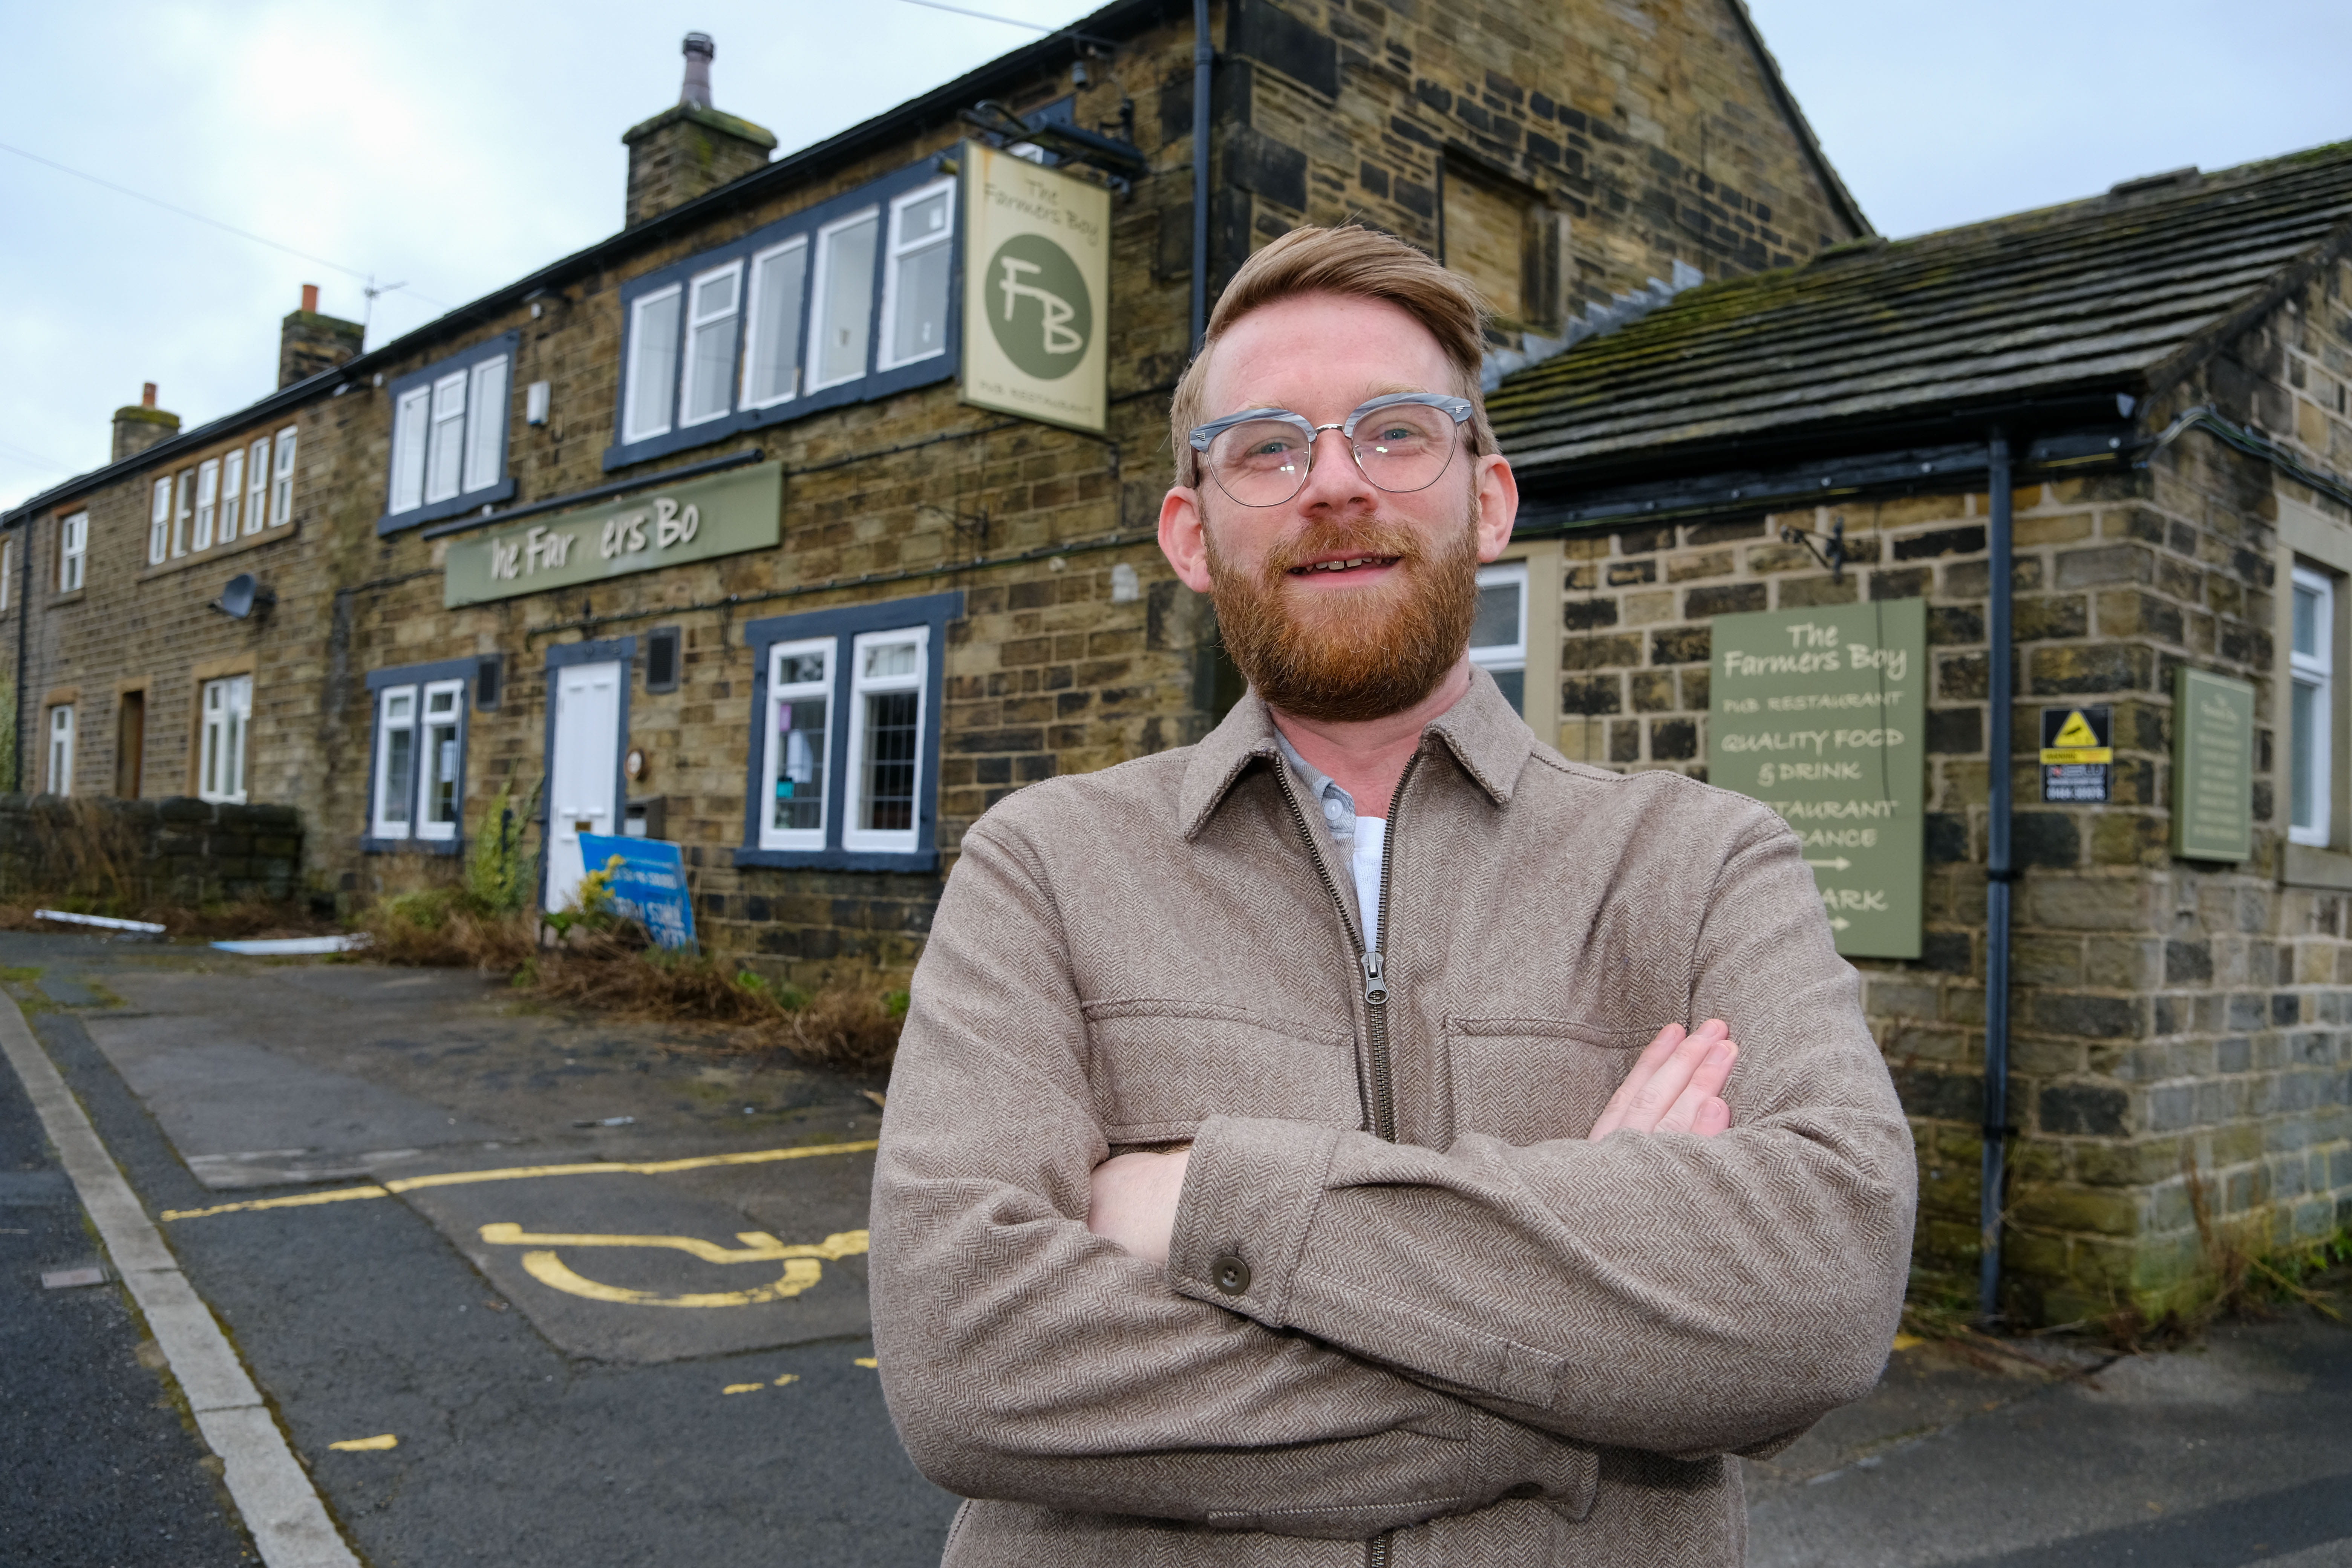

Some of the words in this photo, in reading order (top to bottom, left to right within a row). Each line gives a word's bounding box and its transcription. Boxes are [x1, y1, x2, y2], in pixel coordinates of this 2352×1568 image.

[1024, 179, 1060, 207] The
[983, 182, 1062, 225] Farmers
[1064, 208, 1099, 248] Boy
[1787, 622, 1839, 649] The
[1724, 650, 1841, 677] Farmers
[1847, 643, 1907, 680] Boy
[1723, 698, 1760, 714] PUB
[1768, 691, 1905, 711] RESTAURANT
[1721, 730, 1829, 756] QUALITY
[1834, 728, 1905, 749] FOOD
[1778, 761, 1863, 780] DRINK
[1765, 800, 1900, 819] TAURANT
[1792, 828, 1877, 848] RANCE
[1822, 888, 1889, 911] ARK
